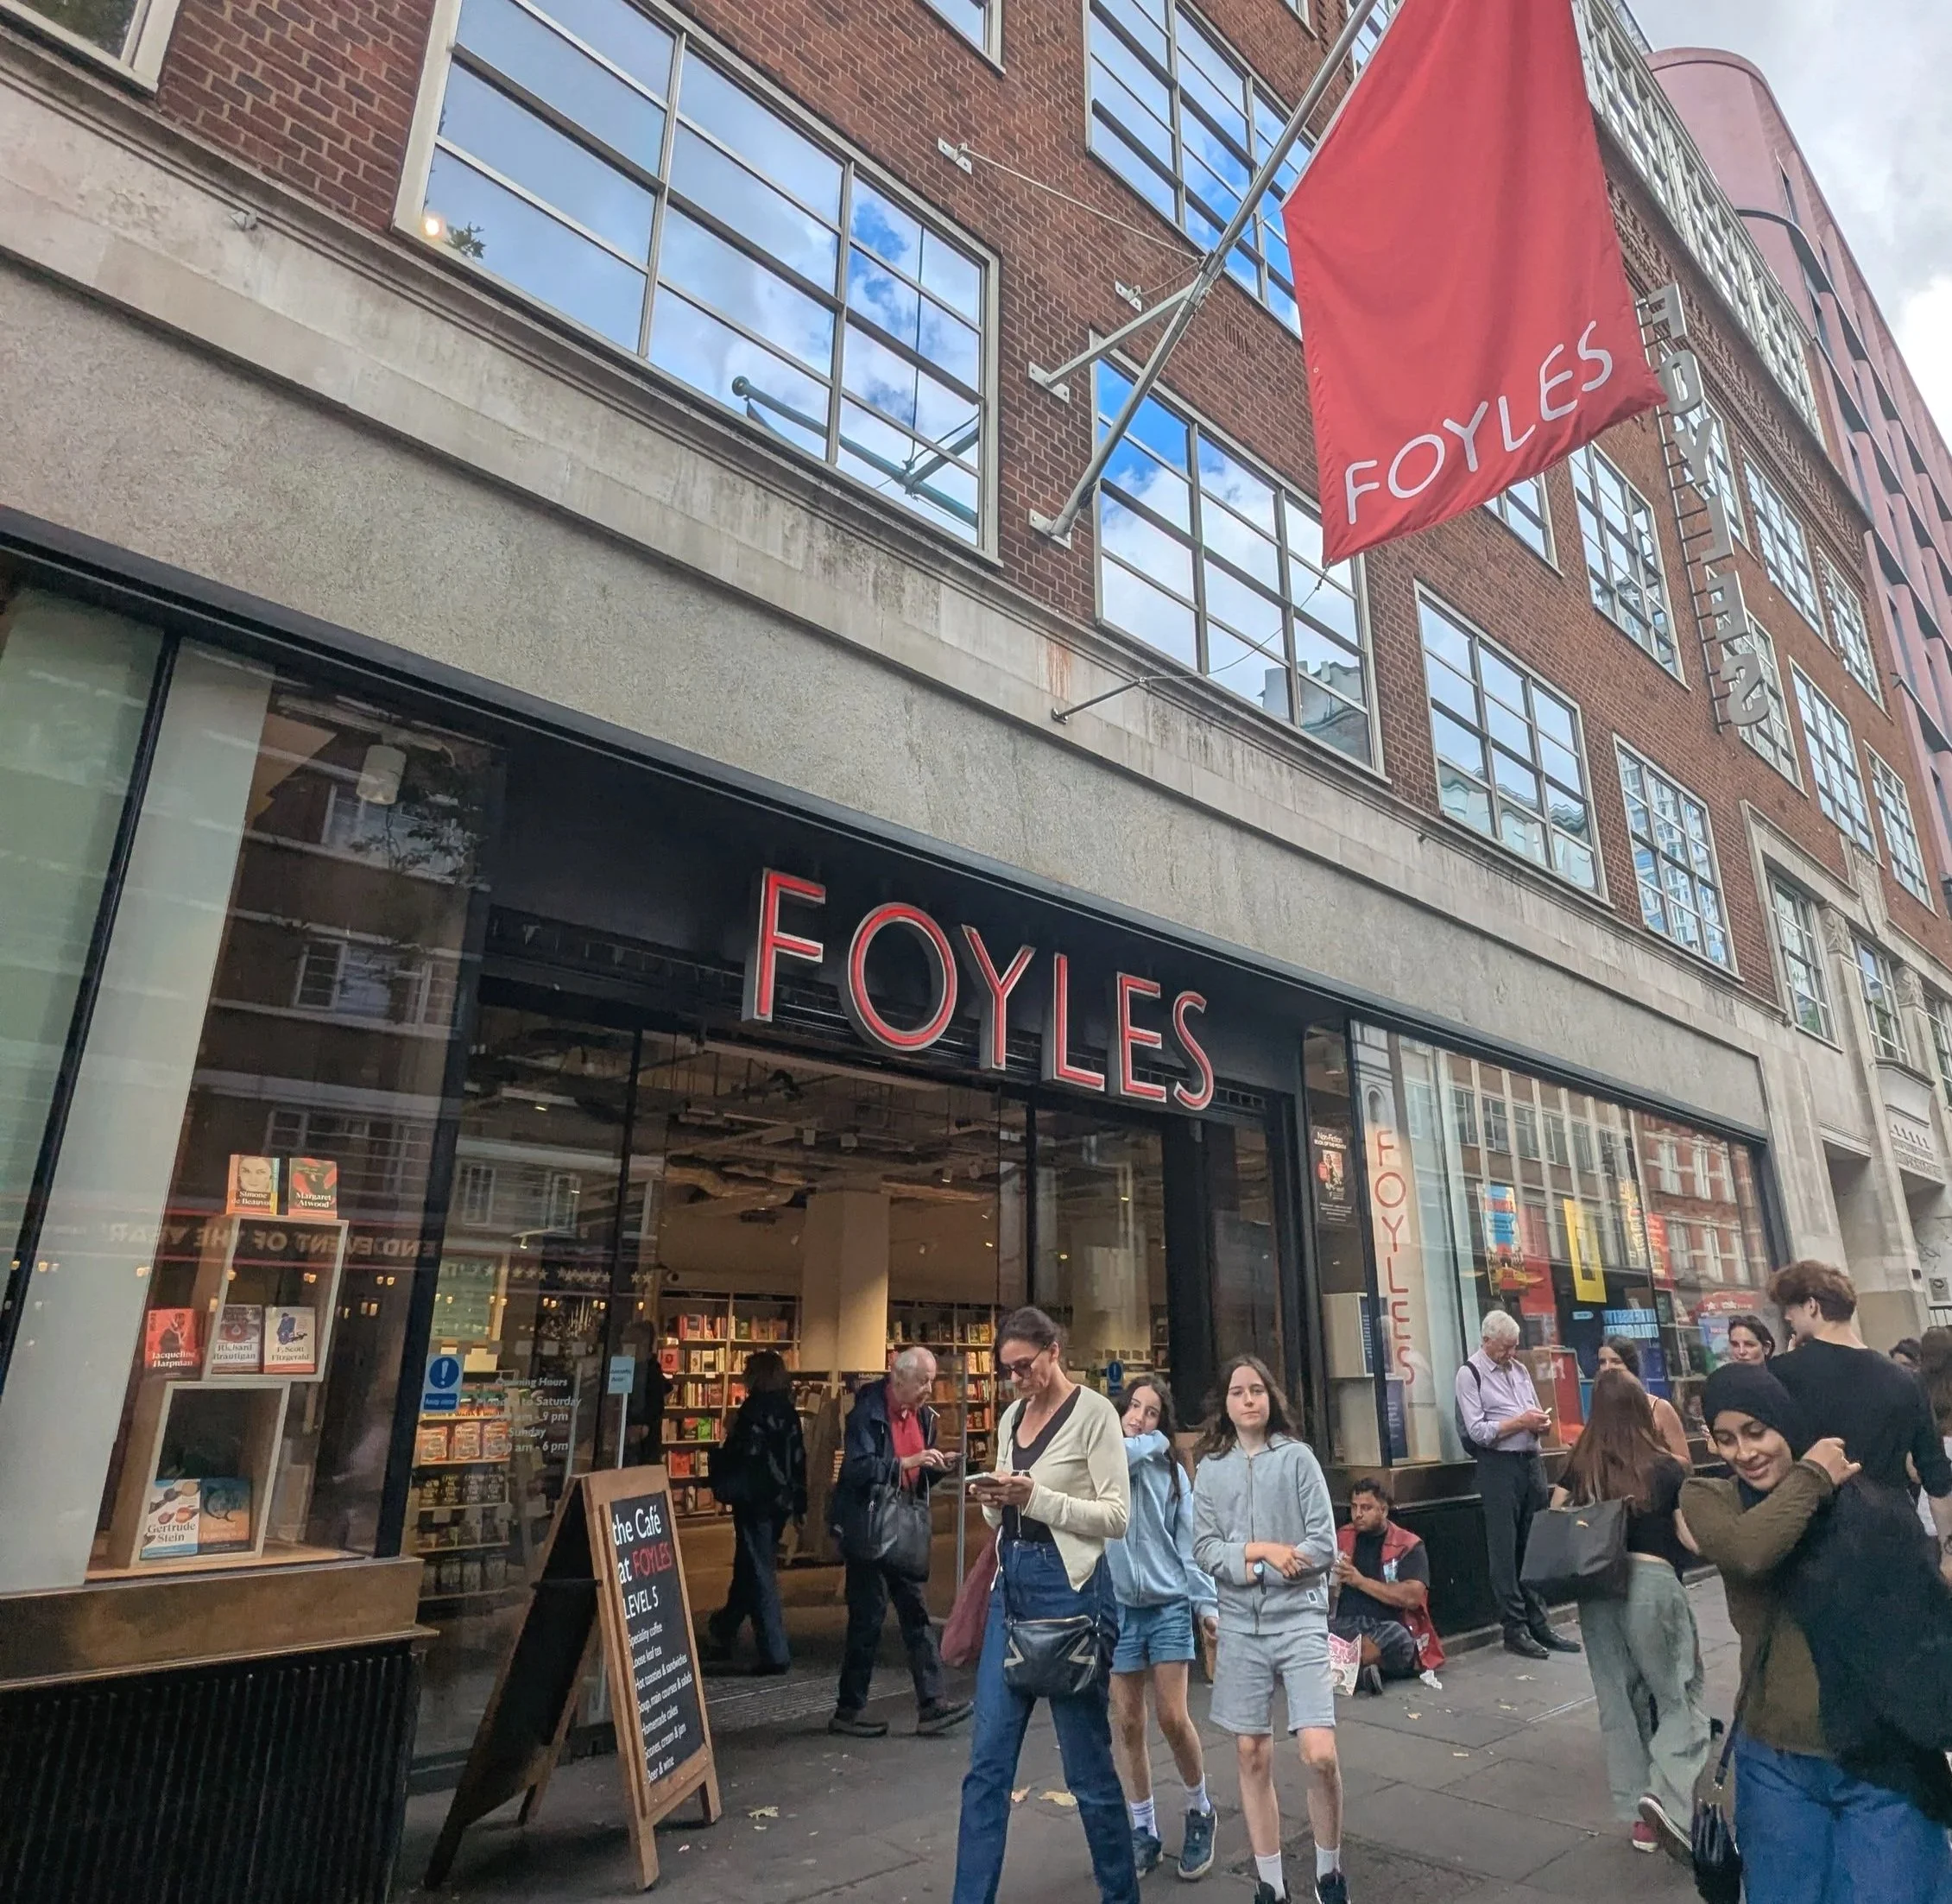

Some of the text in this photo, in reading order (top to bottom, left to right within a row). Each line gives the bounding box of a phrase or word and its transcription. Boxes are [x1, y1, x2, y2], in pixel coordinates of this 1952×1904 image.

[1345, 320, 1613, 525] FOYLES
[744, 867, 1215, 1111] FOYLES
[295, 1192, 332, 1201] Margaret
[298, 1199, 330, 1208] Atwood
[1374, 1129, 1415, 1385] FOYLES
[217, 1344, 253, 1352] Richard
[152, 1351, 195, 1362] Jacqueline
[213, 1351, 256, 1361] Brautigan
[271, 1353, 311, 1362] Fitzgerald
[153, 1360, 194, 1369] Harpman
[539, 1377, 568, 1387] Hours
[536, 1396, 582, 1408] Saturday
[551, 1413, 569, 1424] pm
[509, 1426, 546, 1439] Sunday
[515, 1444, 533, 1452] am
[542, 1441, 549, 1451] 6
[551, 1441, 569, 1453] pm
[148, 1522, 196, 1534] Gertrude
[612, 1504, 661, 1546] the Café
[157, 1533, 185, 1543] Stein
[617, 1541, 673, 1584] at FOYLES
[622, 1585, 659, 1620] LEVEL 5
[649, 1622, 663, 1637] coffee
[646, 1646, 655, 1660] leaf
[661, 1663, 666, 1676] &
[651, 1692, 662, 1706] main
[661, 1683, 678, 1699] courses
[680, 1671, 692, 1687] salads
[666, 1705, 679, 1720] cakes
[678, 1723, 686, 1740] jam
[659, 1762, 664, 1775] &
[663, 1756, 674, 1771] wine
